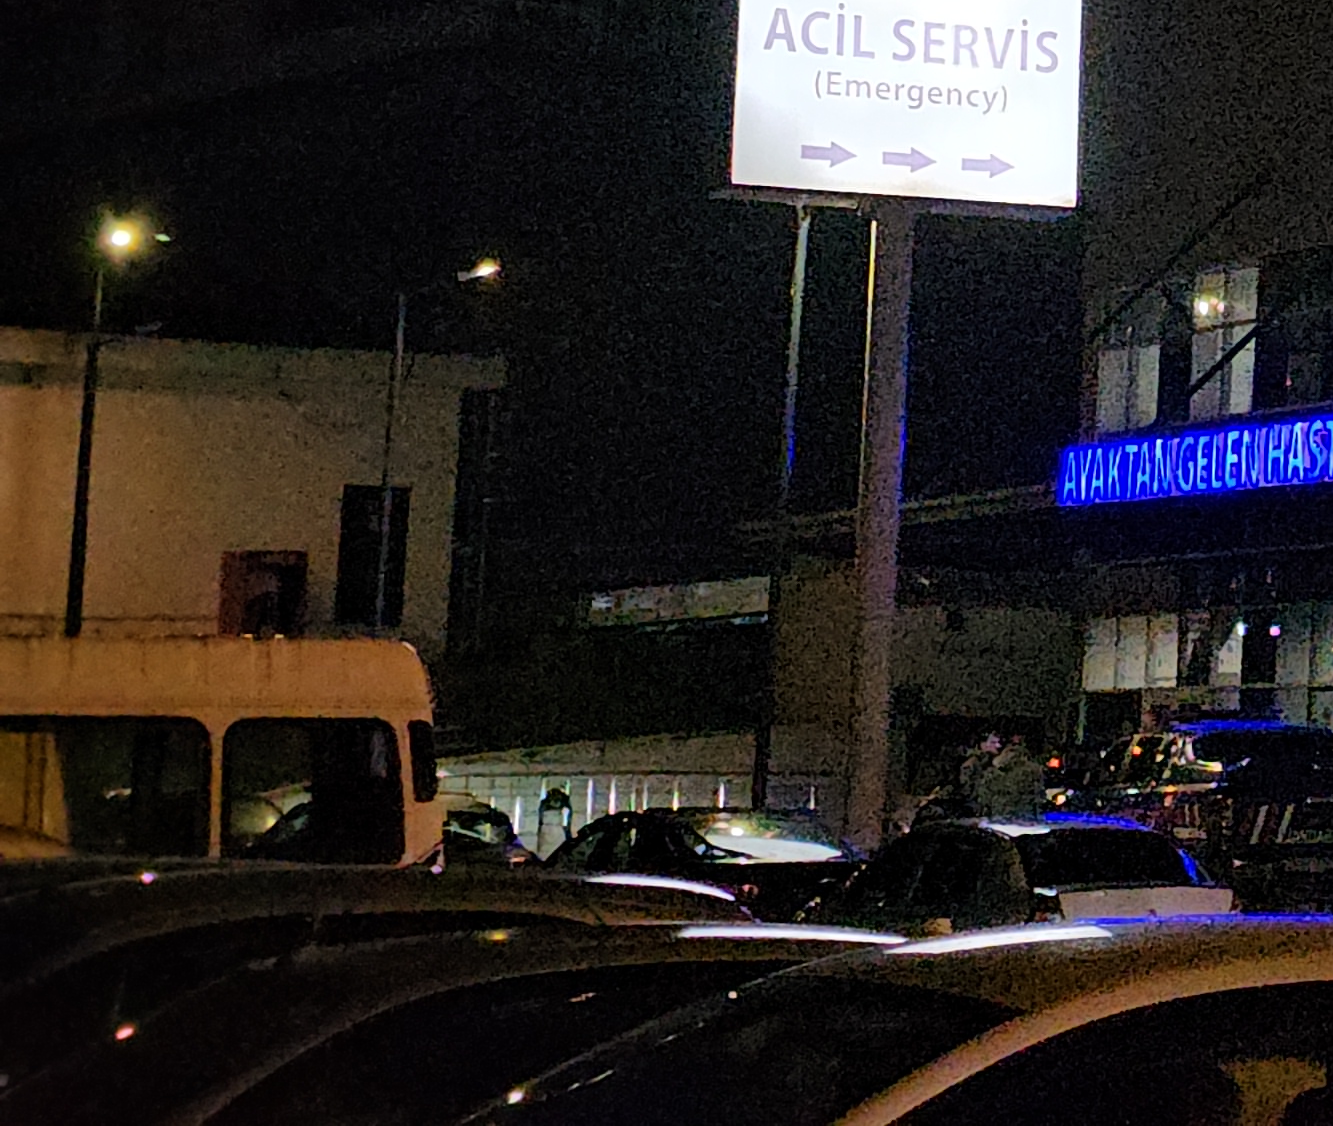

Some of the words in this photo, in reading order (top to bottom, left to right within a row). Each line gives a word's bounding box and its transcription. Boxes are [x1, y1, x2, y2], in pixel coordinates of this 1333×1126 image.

[763, 3, 875, 60] ACİL
[892, 19, 1060, 74] SERVİS
[815, 70, 1009, 115] (Emergency)
